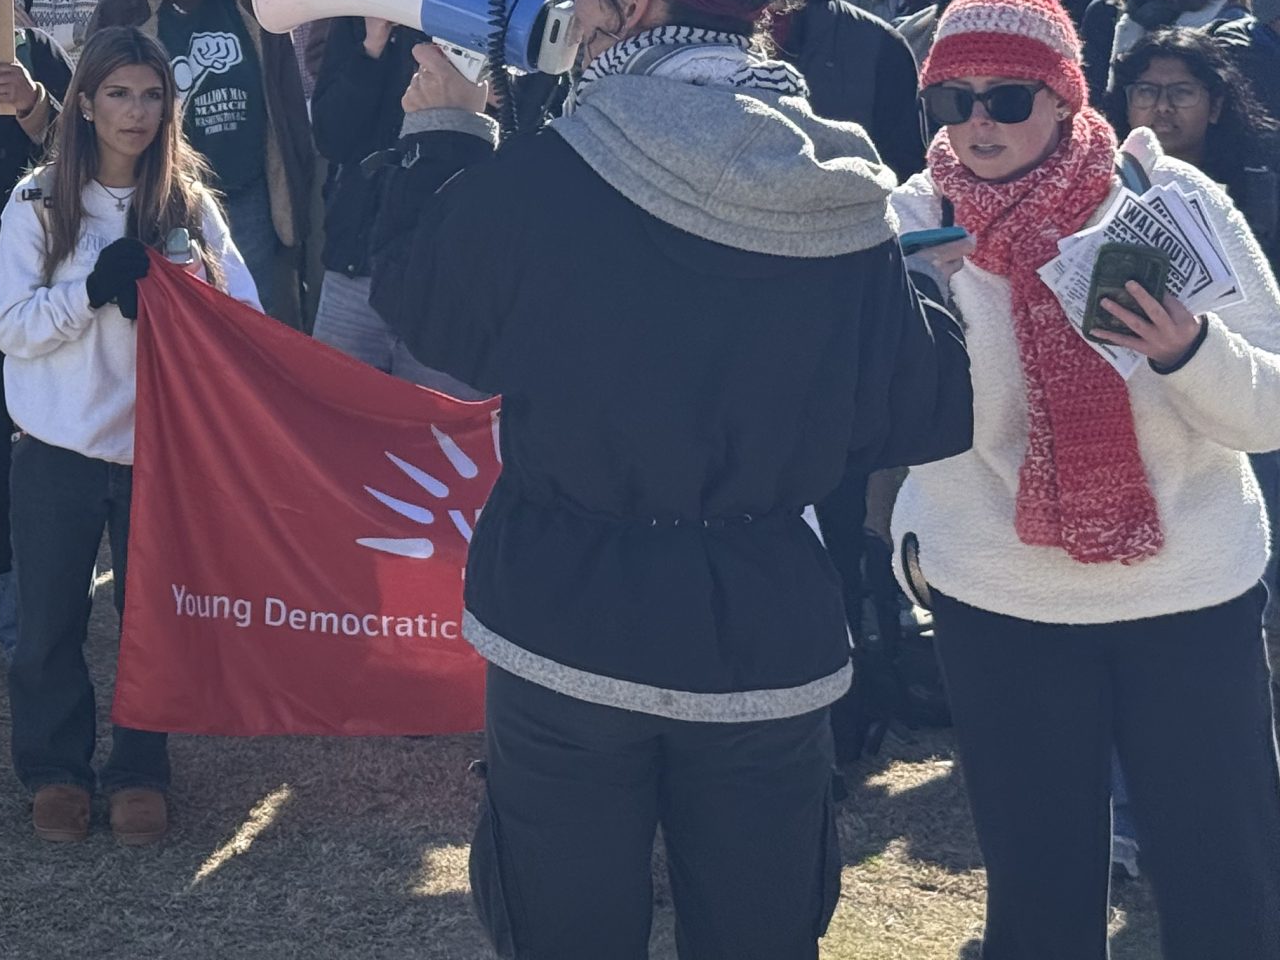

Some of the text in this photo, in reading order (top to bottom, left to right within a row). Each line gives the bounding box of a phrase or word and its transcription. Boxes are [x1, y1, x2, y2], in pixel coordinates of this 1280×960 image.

[195, 88, 228, 107] MILLION
[195, 100, 246, 116] MARCH
[1123, 202, 1192, 273] WALKOUT!
[172, 583, 458, 640] Young Democratic
